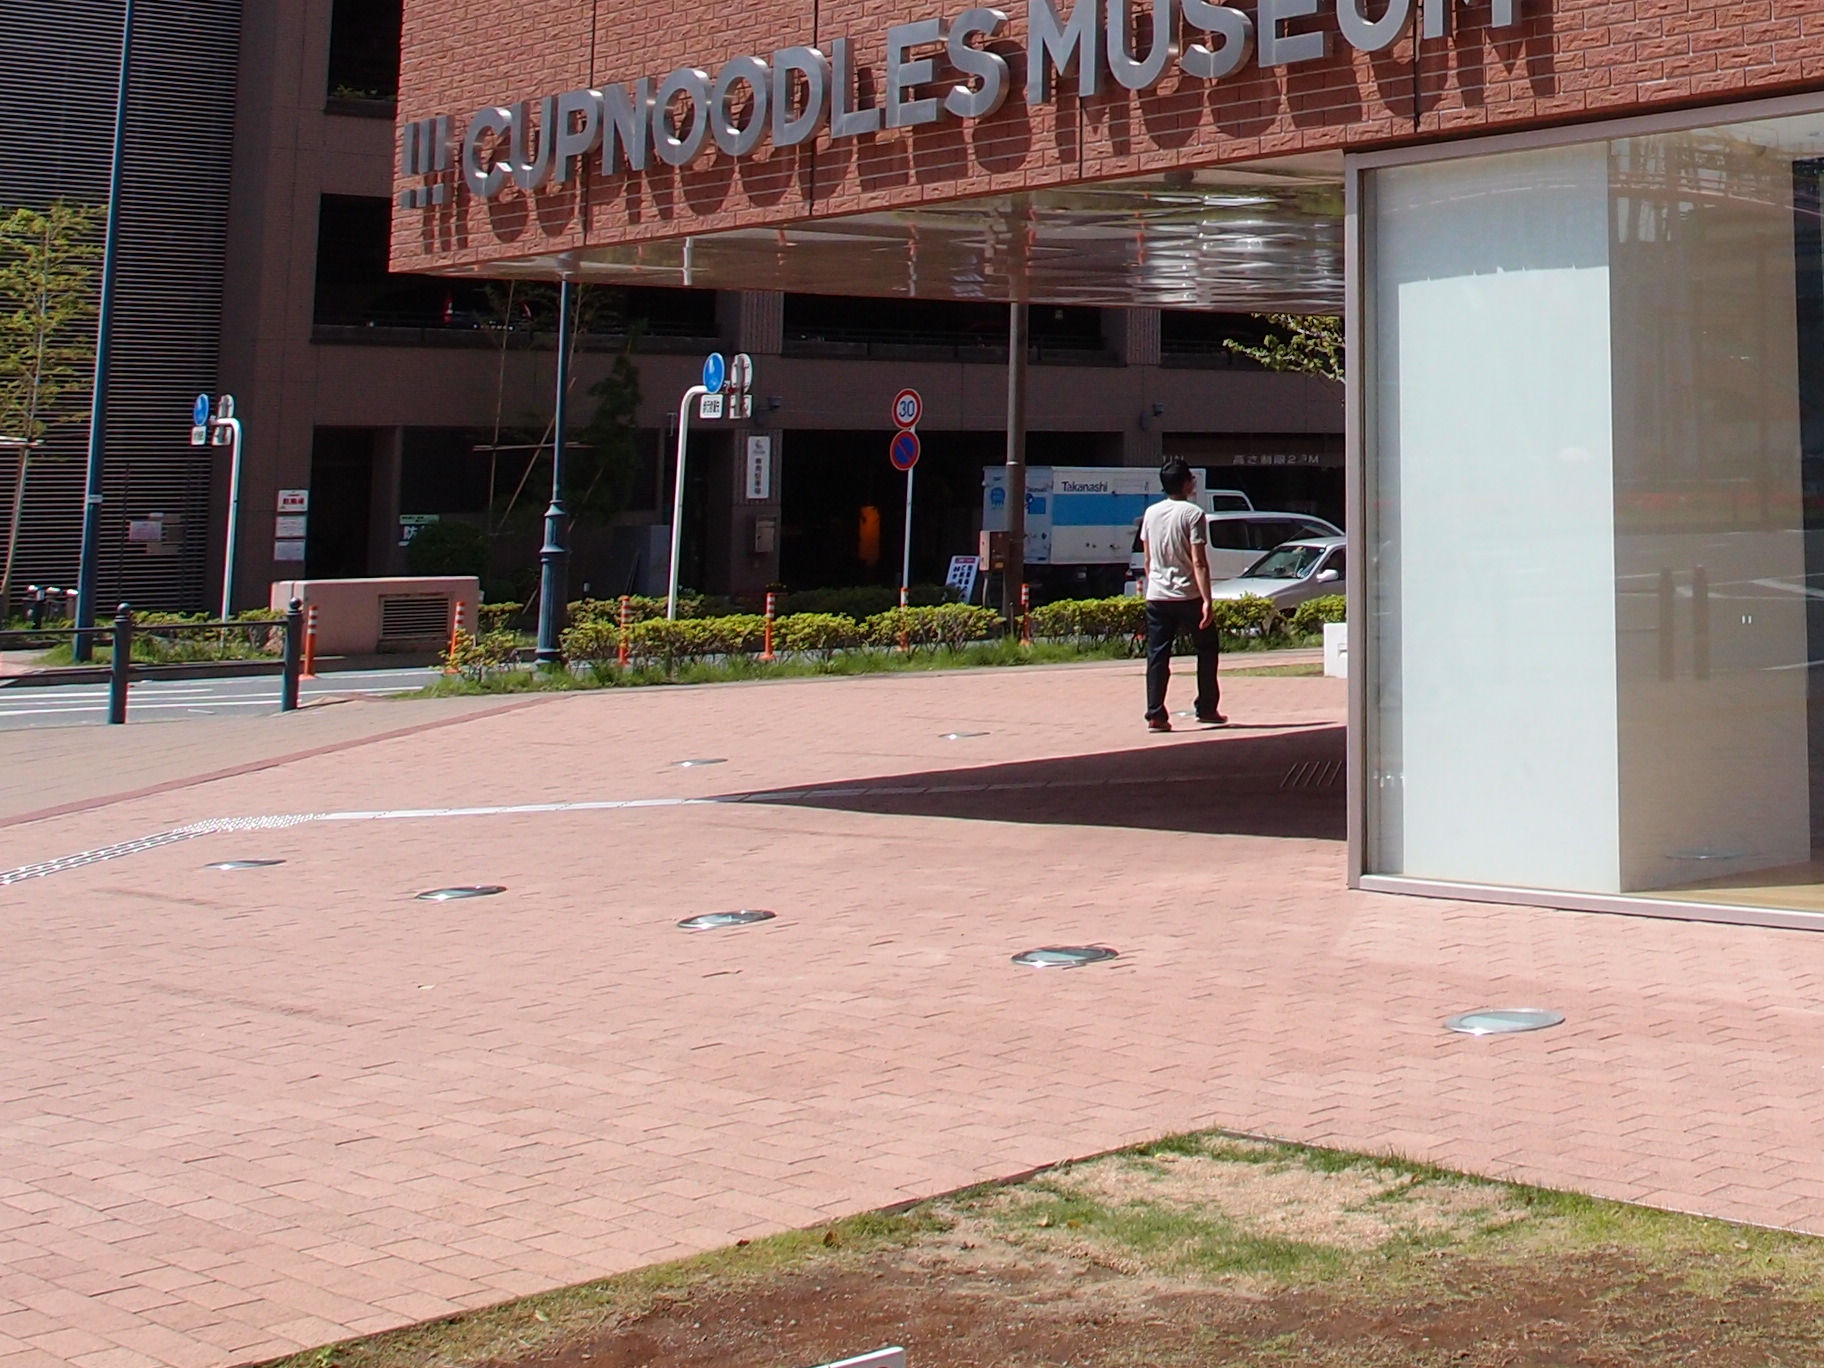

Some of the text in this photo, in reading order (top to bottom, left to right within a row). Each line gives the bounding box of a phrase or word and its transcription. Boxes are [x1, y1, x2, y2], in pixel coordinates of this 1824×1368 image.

[462, 6, 1010, 198] CUPNOODLES
[899, 400, 915, 418] 30
[1061, 481, 1108, 493] Takanashi
